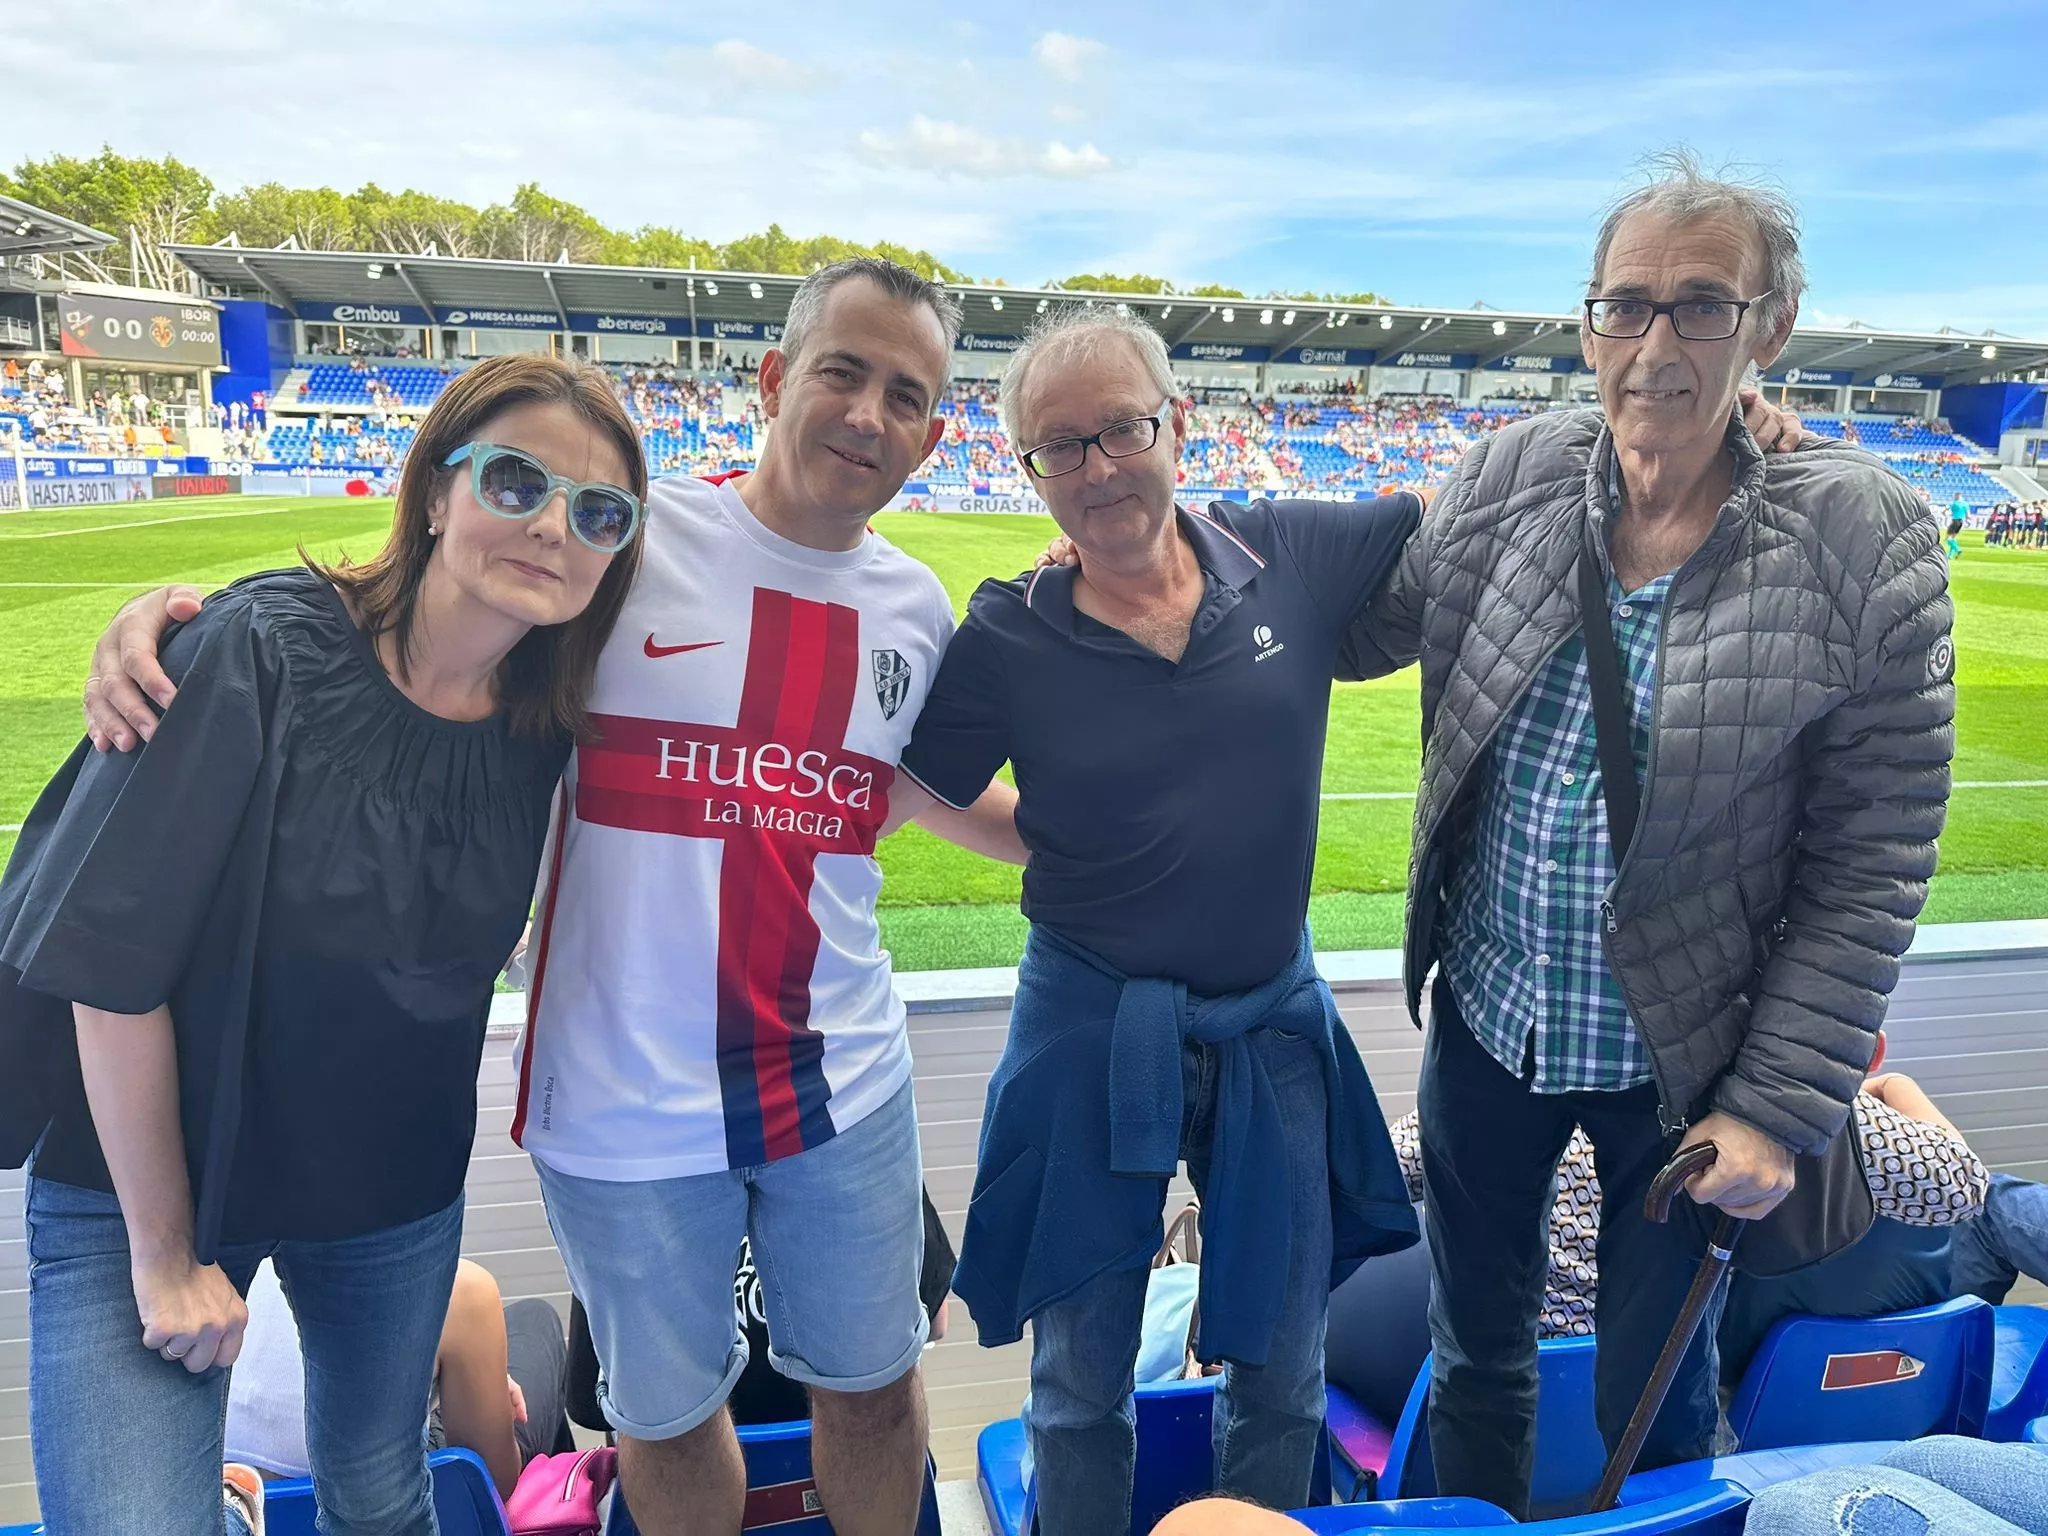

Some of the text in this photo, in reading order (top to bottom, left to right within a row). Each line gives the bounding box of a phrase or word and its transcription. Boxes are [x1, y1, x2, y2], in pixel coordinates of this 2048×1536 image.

[181, 309, 212, 322] IBOR
[333, 305, 401, 323] embou
[470, 311, 557, 324] HUESCA GARDEN
[182, 329, 215, 343] 00:00
[1314, 350, 1347, 363] arnal
[210, 462, 254, 476] IBOR
[32, 483, 76, 505] HASTA
[79, 483, 98, 502] 300
[101, 482, 116, 500] TN
[1254, 643, 1284, 662] ARTENGO
